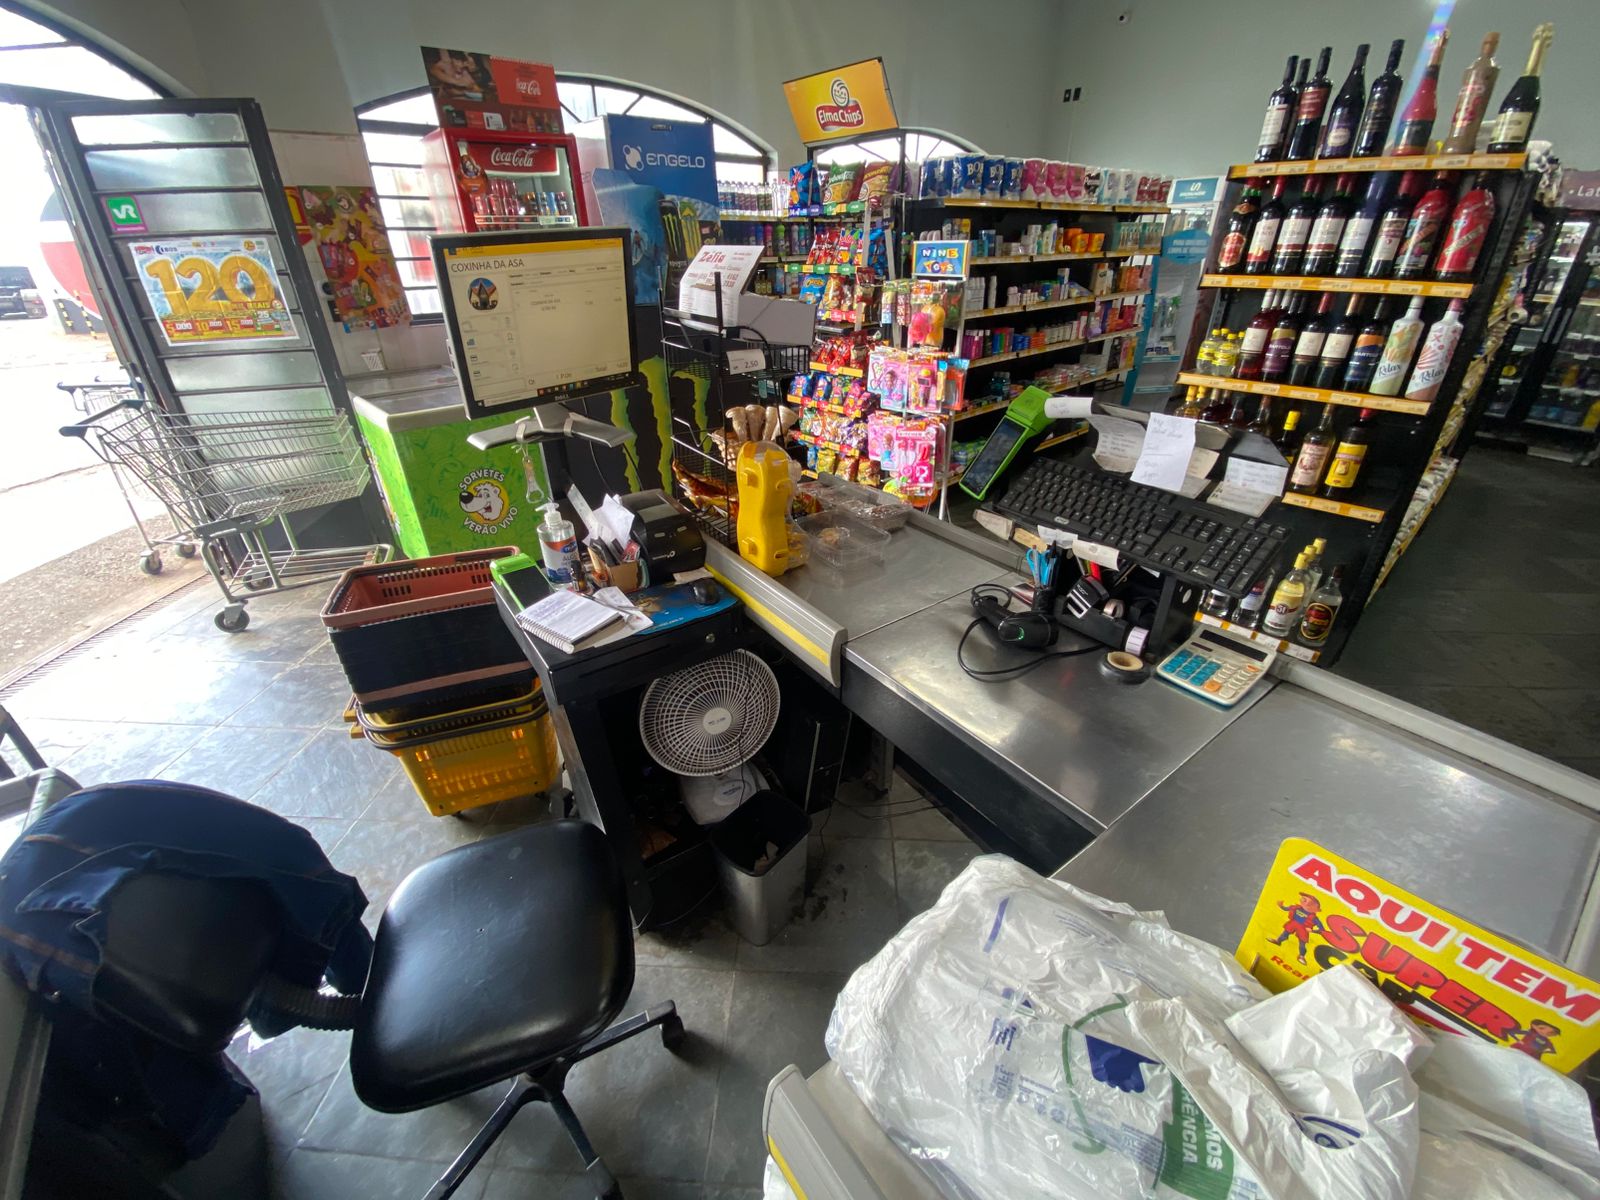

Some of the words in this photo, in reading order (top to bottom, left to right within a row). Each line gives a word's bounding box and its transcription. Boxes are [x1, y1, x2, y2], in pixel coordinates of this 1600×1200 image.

[490, 146, 534, 168] Coca-Cola
[645, 152, 706, 169] ENGELO
[922, 248, 959, 259] NINE
[450, 260, 492, 273] COXINHA
[493, 259, 506, 269] DA
[507, 257, 525, 268] ASA
[923, 260, 955, 274] TOYS
[145, 254, 276, 318] 120
[1378, 363, 1402, 378] Relax
[1419, 367, 1445, 383] Relax
[459, 468, 505, 491] SORVETES
[463, 516, 498, 535] VERÃO
[499, 505, 518, 530] VIVO
[1278, 604, 1287, 614] 51
[1293, 856, 1451, 949] AQUI
[1458, 936, 1600, 1023] TEM
[1319, 913, 1521, 1043] SUPER
